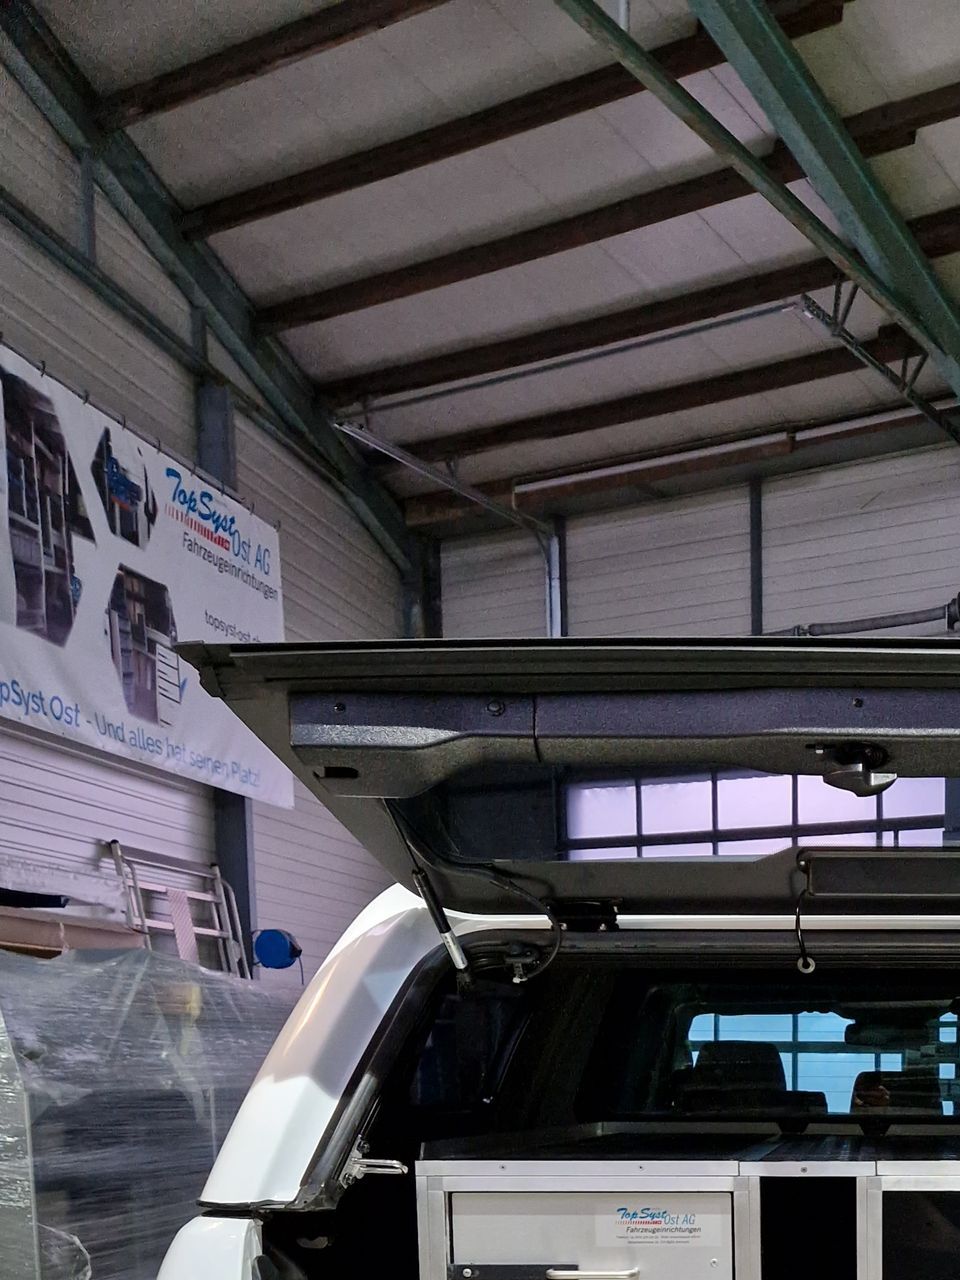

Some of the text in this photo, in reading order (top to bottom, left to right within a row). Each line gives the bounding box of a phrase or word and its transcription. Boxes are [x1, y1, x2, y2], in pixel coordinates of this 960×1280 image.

[165, 467, 271, 575] TopSyst Ost AG
[182, 532, 279, 600] Fahrzeugeinrichtungen
[50, 695, 80, 727] Ost
[94, 712, 126, 743] Und
[129, 727, 163, 756] alles
[166, 737, 187, 763] hat
[617, 1208, 696, 1225] TopSyst Ost AG
[626, 1226, 701, 1234] Fahrzeugeinrichtungen
